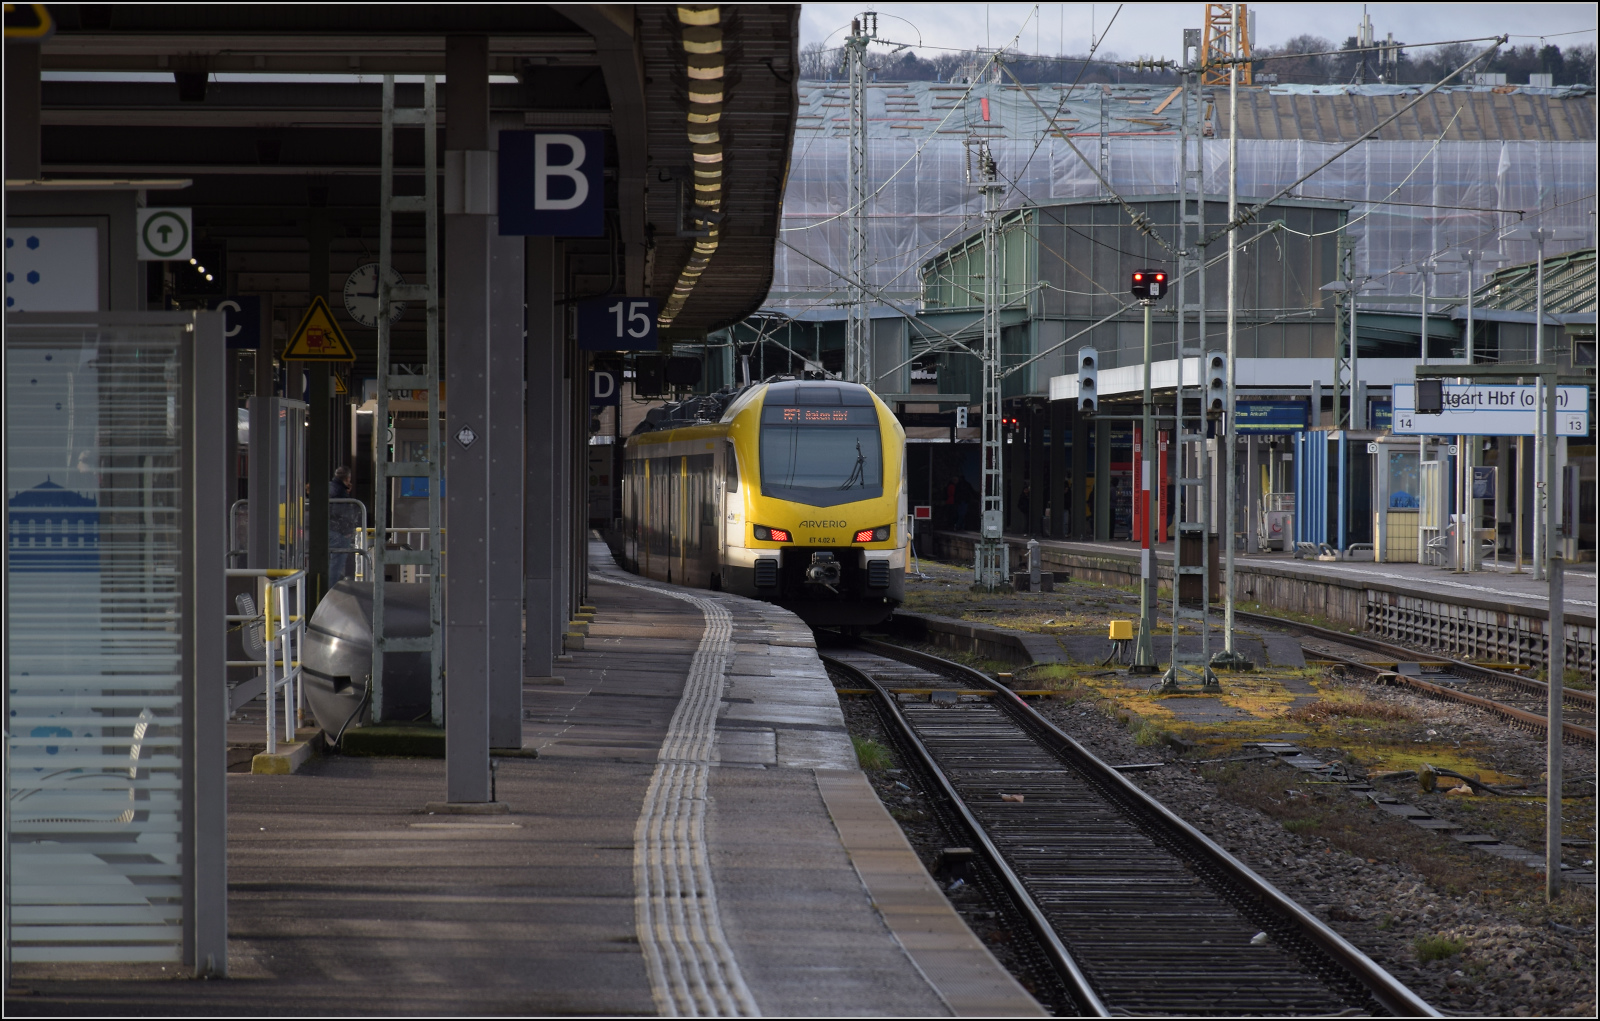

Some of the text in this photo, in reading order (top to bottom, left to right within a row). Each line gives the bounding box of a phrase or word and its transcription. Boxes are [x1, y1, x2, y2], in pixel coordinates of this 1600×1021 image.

[534, 133, 590, 211] B
[215, 299, 243, 338] C
[608, 301, 651, 338] 15
[593, 371, 614, 399] D
[1488, 391, 1516, 405] Hbf
[1520, 389, 1568, 408] (on)
[1399, 419, 1413, 429] 14
[1568, 420, 1582, 431] 13
[798, 520, 847, 529] ARVERIO
